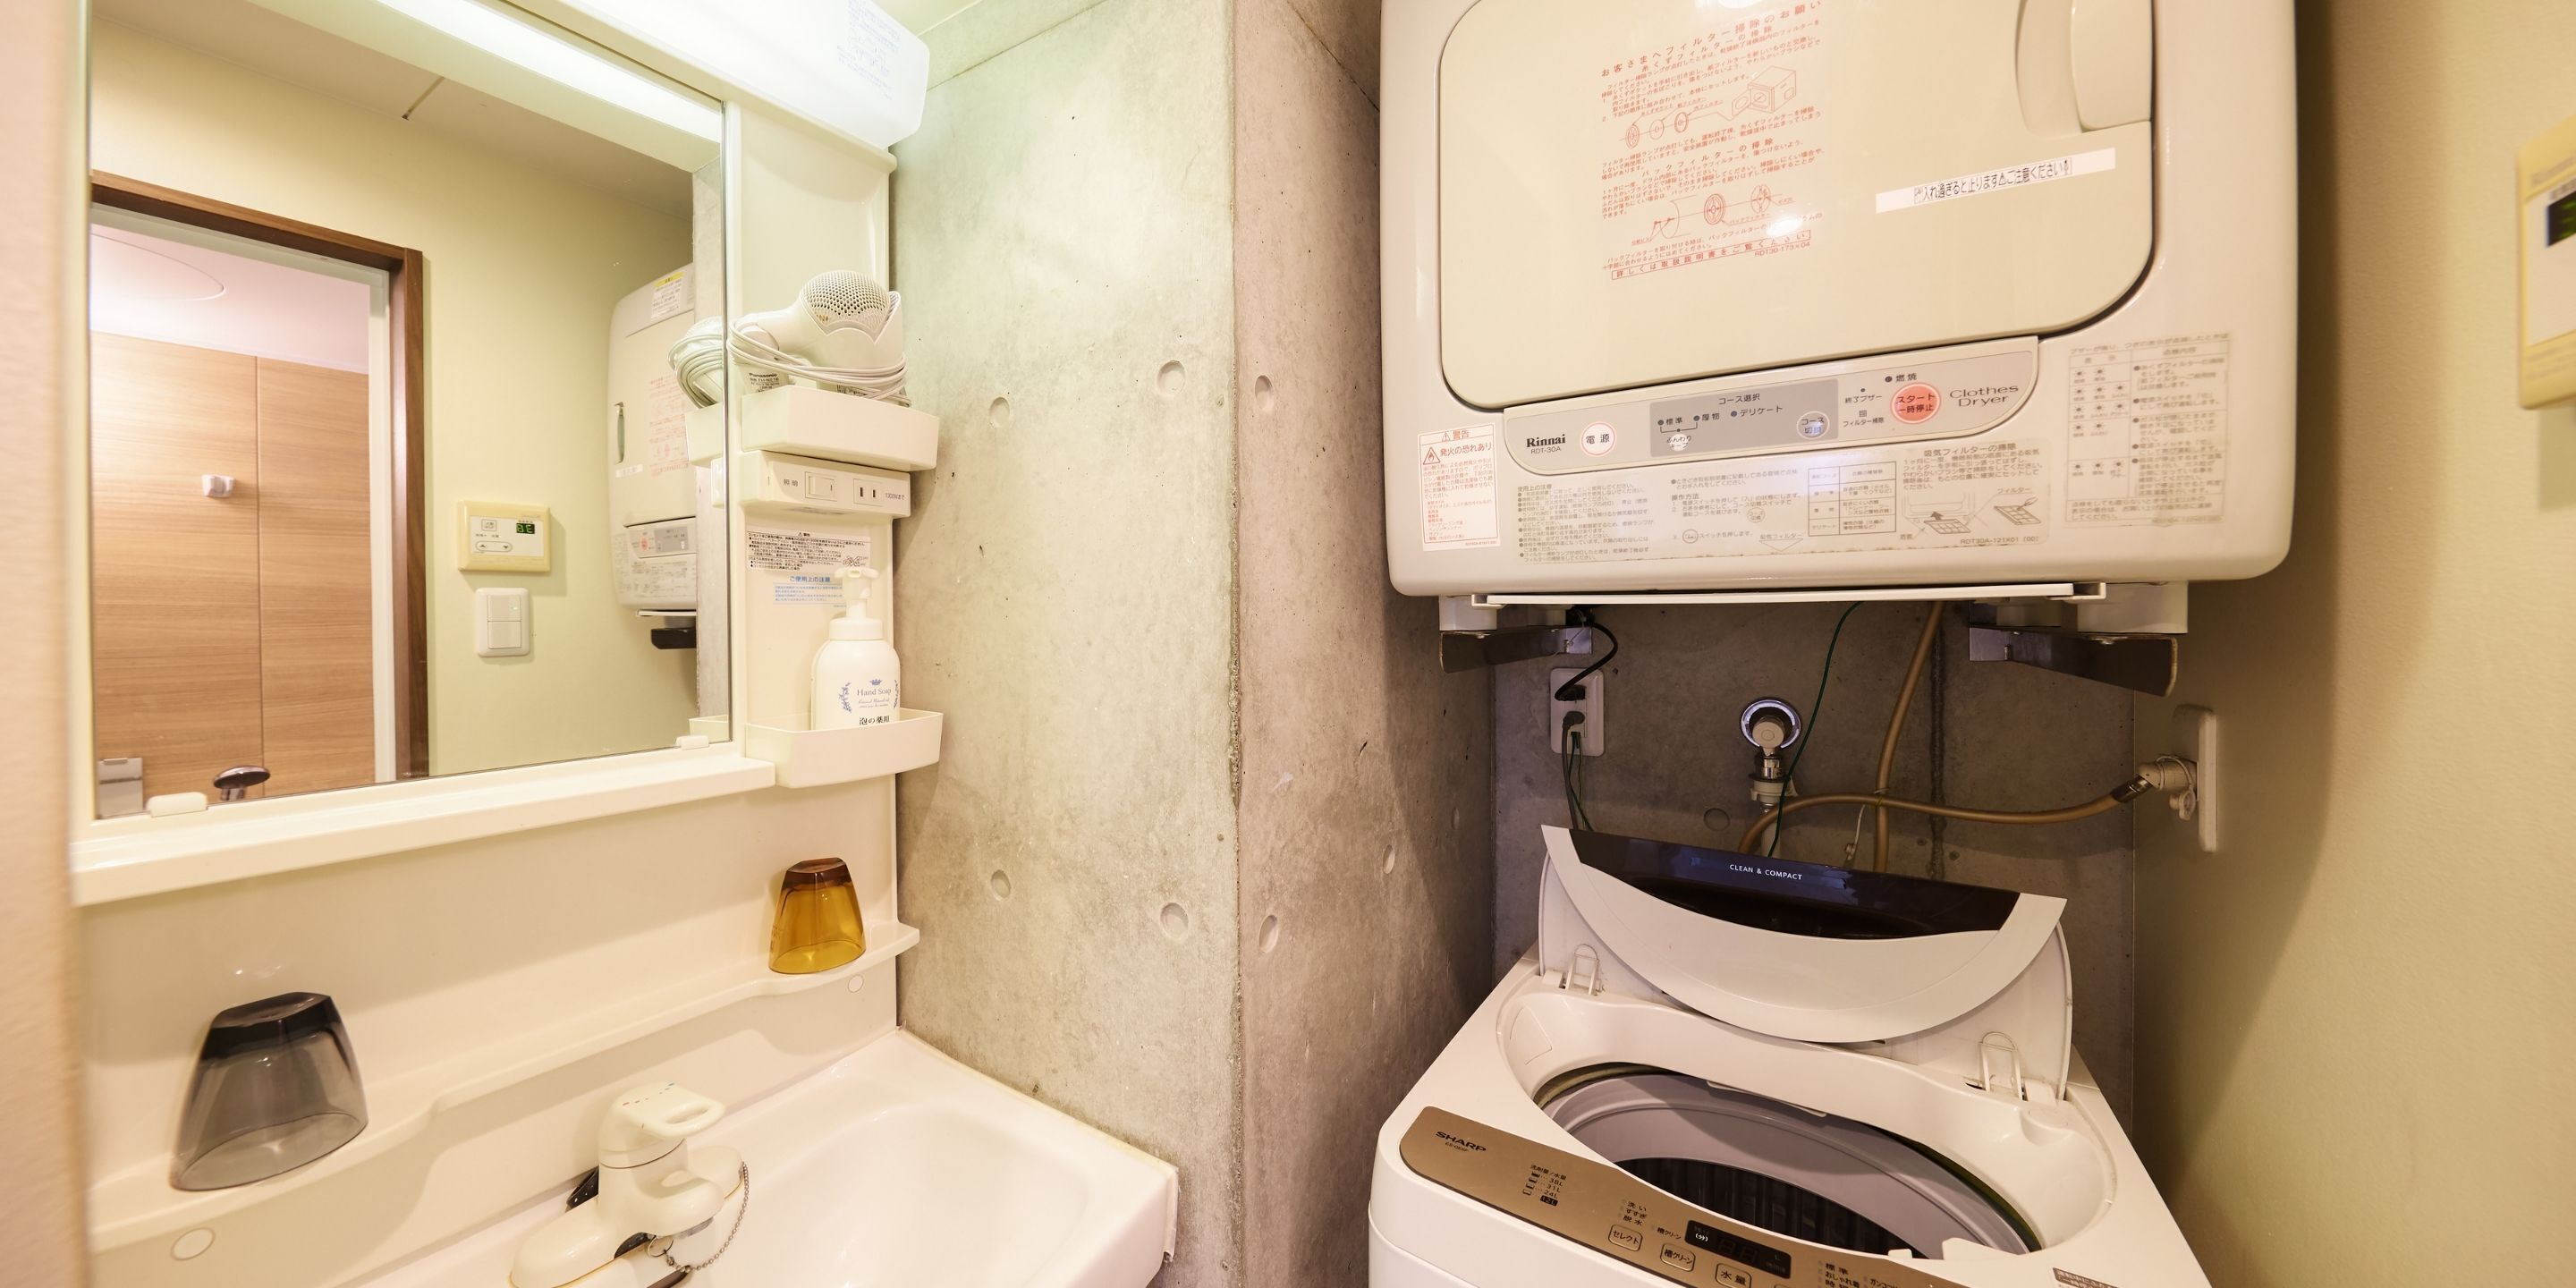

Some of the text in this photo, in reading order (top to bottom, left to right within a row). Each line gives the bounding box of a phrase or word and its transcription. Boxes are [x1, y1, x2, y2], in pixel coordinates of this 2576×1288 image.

[1896, 372, 1917, 382] 燃焼
[1897, 392, 1936, 403] スタート
[1950, 385, 2019, 399] Clothes
[1718, 394, 1760, 405] コース選択
[1959, 394, 2010, 407] Dryer
[1740, 405, 1783, 417] デリケート
[1898, 404, 1934, 413] 一時停止
[1801, 417, 1825, 426] コース
[1526, 434, 1566, 448] Rinnai
[1586, 434, 1610, 445] 電源
[1440, 443, 1492, 456] 発火の恐れあり
[1530, 446, 1562, 454] RDT-30A
[878, 688, 891, 696] Soap
[1729, 864, 1753, 873] CLEAN
[1765, 869, 1802, 880] COMPACT
[1436, 1131, 1487, 1152] SHARP
[1627, 1201, 1647, 1211] 洗い
[1626, 1208, 1648, 1218] すすぎ
[1613, 1230, 1640, 1244] セレクト
[1664, 1249, 1693, 1265] 槽クリーン
